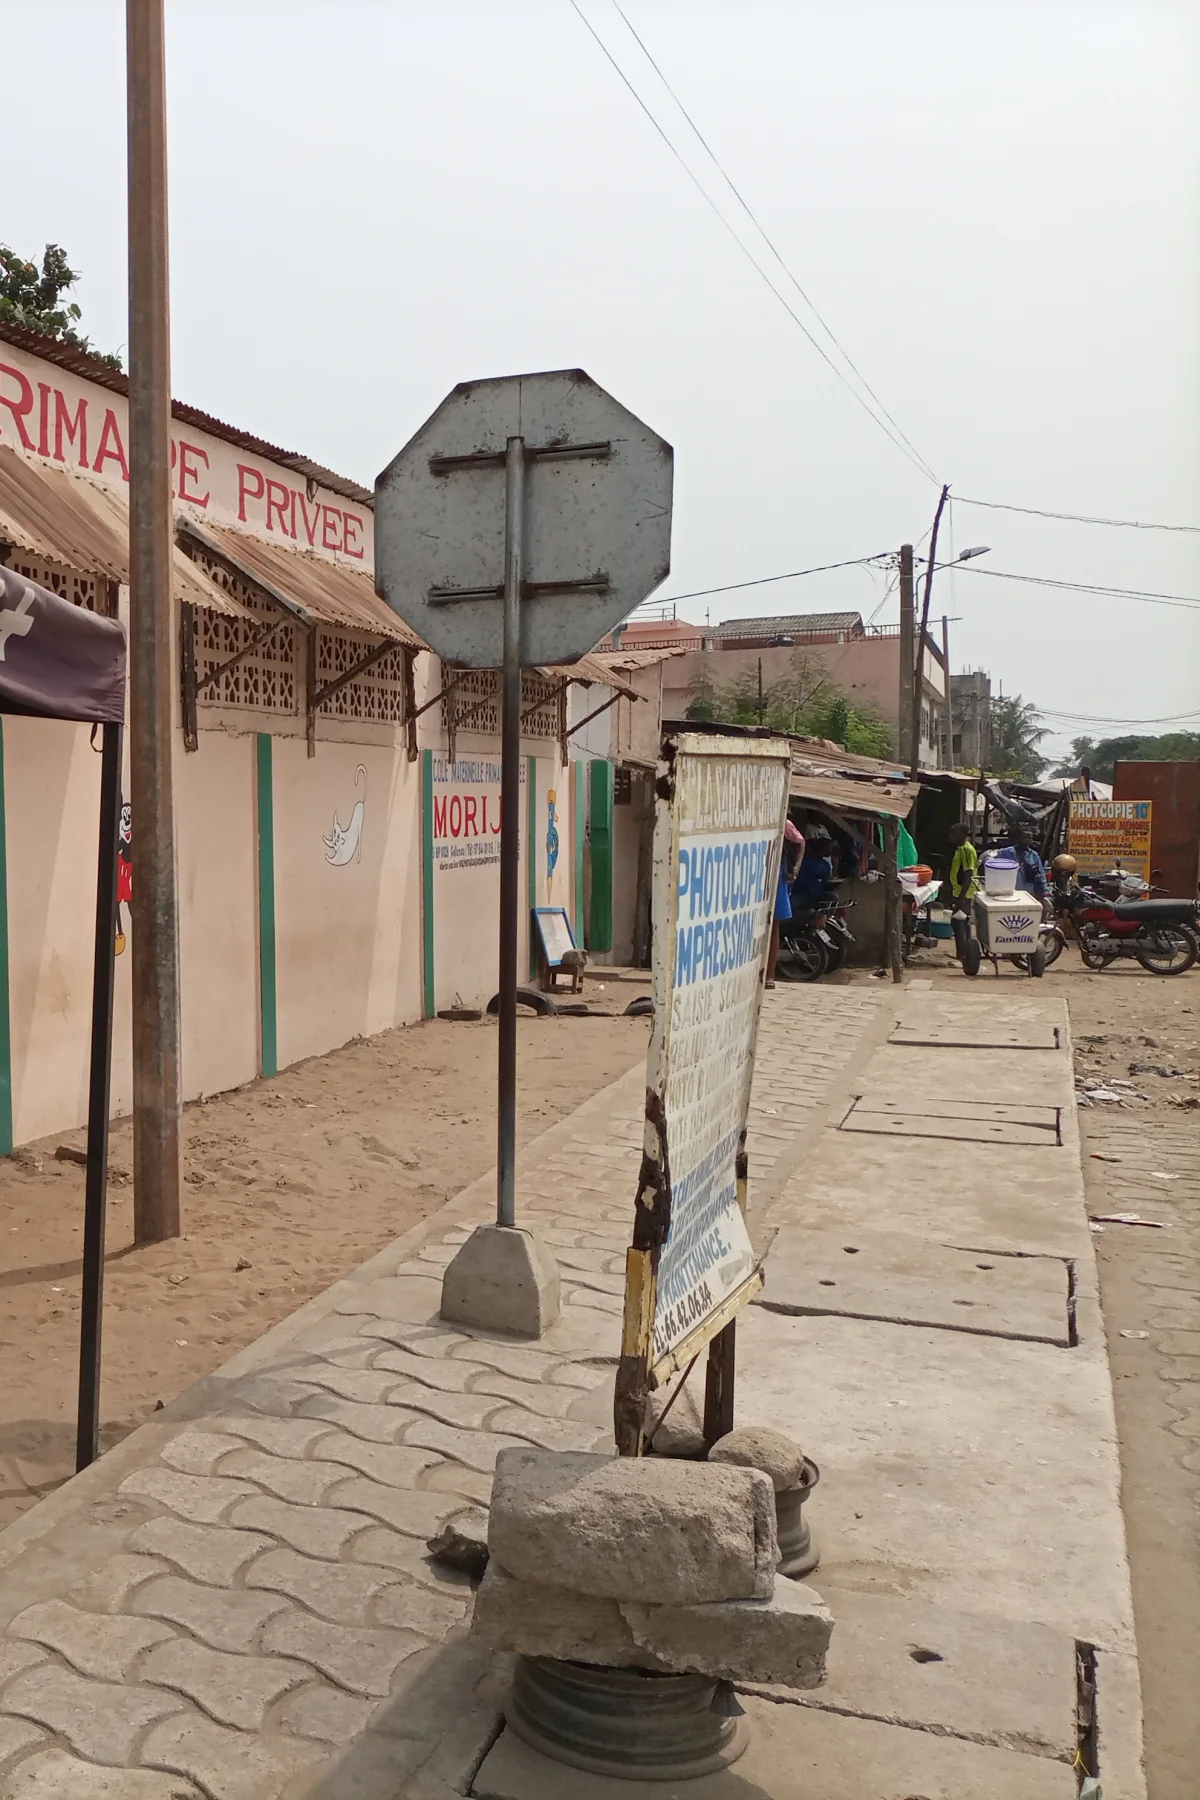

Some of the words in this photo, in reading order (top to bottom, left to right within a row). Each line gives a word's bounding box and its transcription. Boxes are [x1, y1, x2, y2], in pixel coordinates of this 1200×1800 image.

[237, 463, 364, 559] PRIVEE
[433, 794, 488, 839] MORI
[714, 763, 758, 828] SAGESSE
[1070, 803, 1134, 819] PHOTCOPIE
[1070, 820, 1116, 830] IMPRESSION
[676, 840, 768, 922] PHOTOCOPIE
